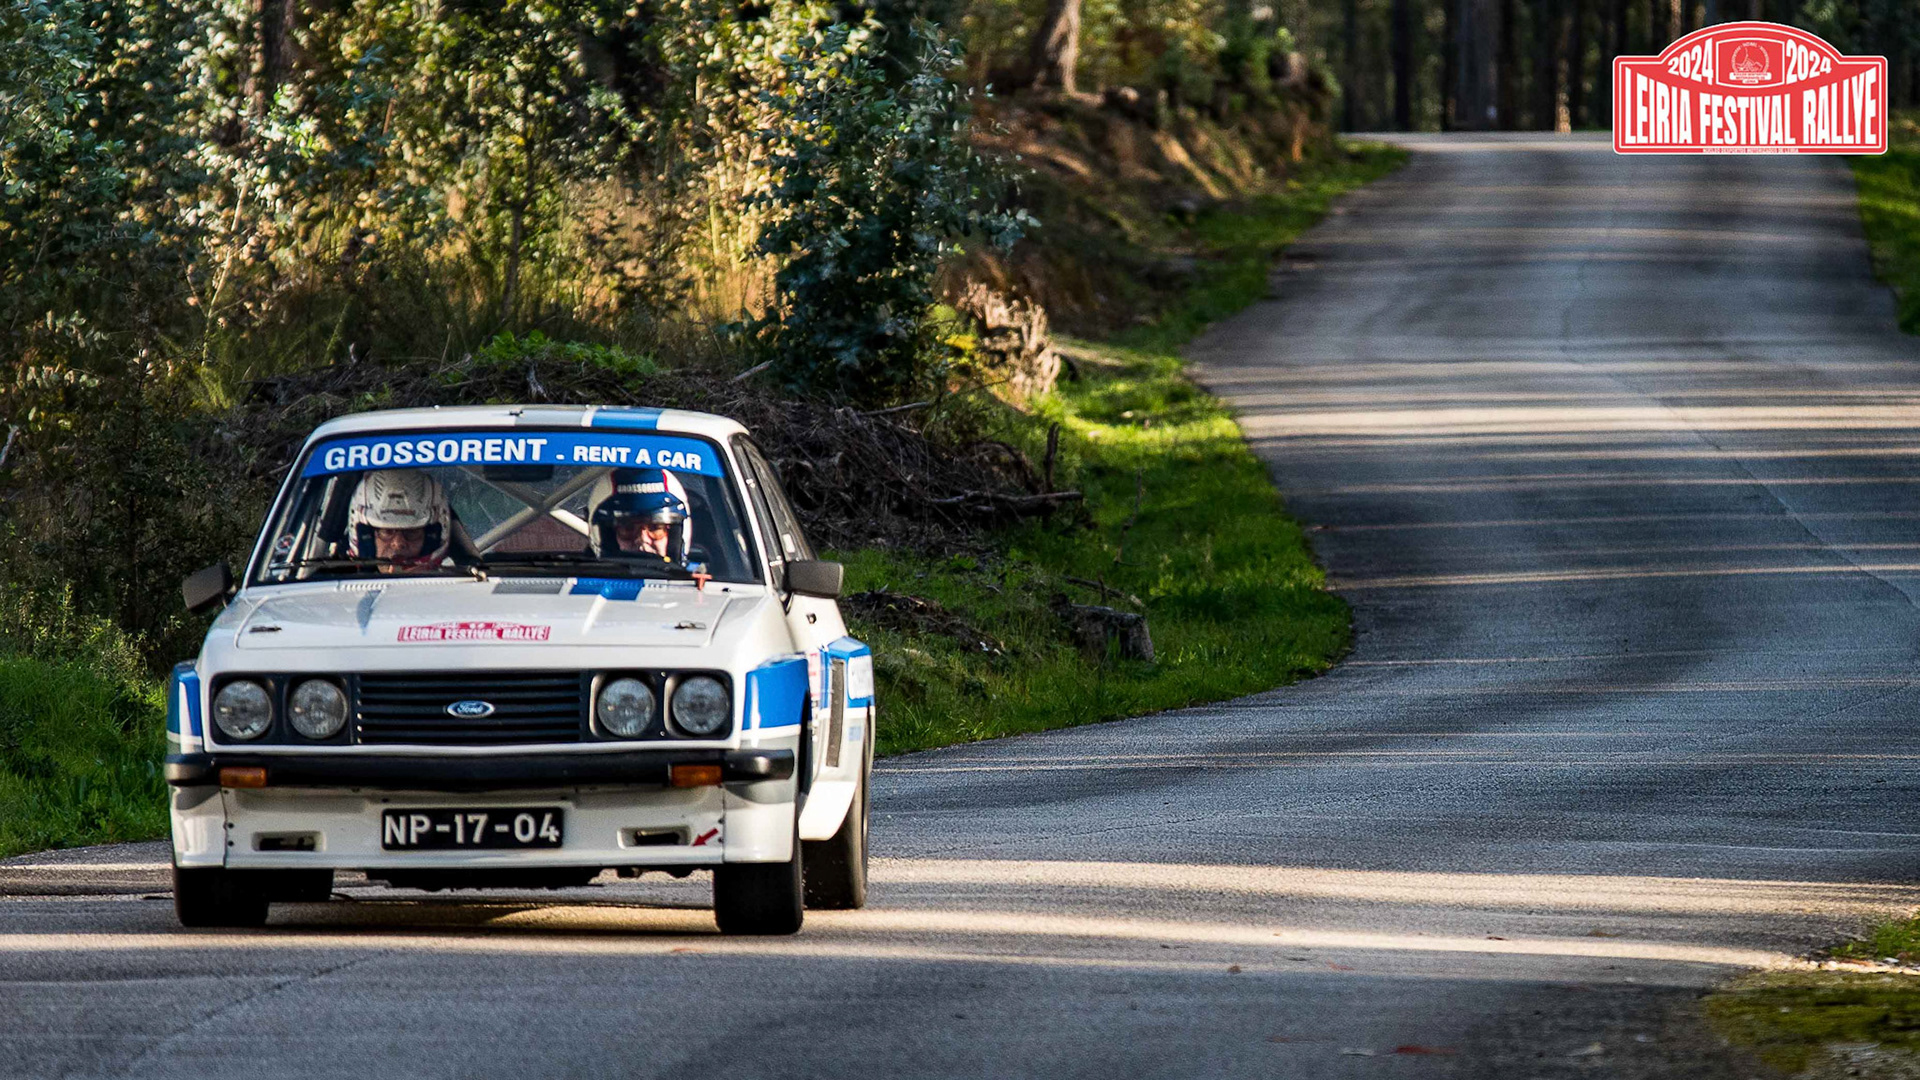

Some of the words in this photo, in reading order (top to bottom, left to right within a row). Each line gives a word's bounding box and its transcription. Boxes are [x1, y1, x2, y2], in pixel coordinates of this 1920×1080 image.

[324, 438, 548, 471] GROSSORENT
[573, 445, 631, 464] RENT
[635, 448, 651, 465] A
[657, 449, 702, 471] CAR
[403, 626, 442, 640] LEIRIA
[445, 628, 499, 640] FESTIVAL
[502, 626, 546, 640] RALLYE
[384, 812, 560, 845] NP-17-04
